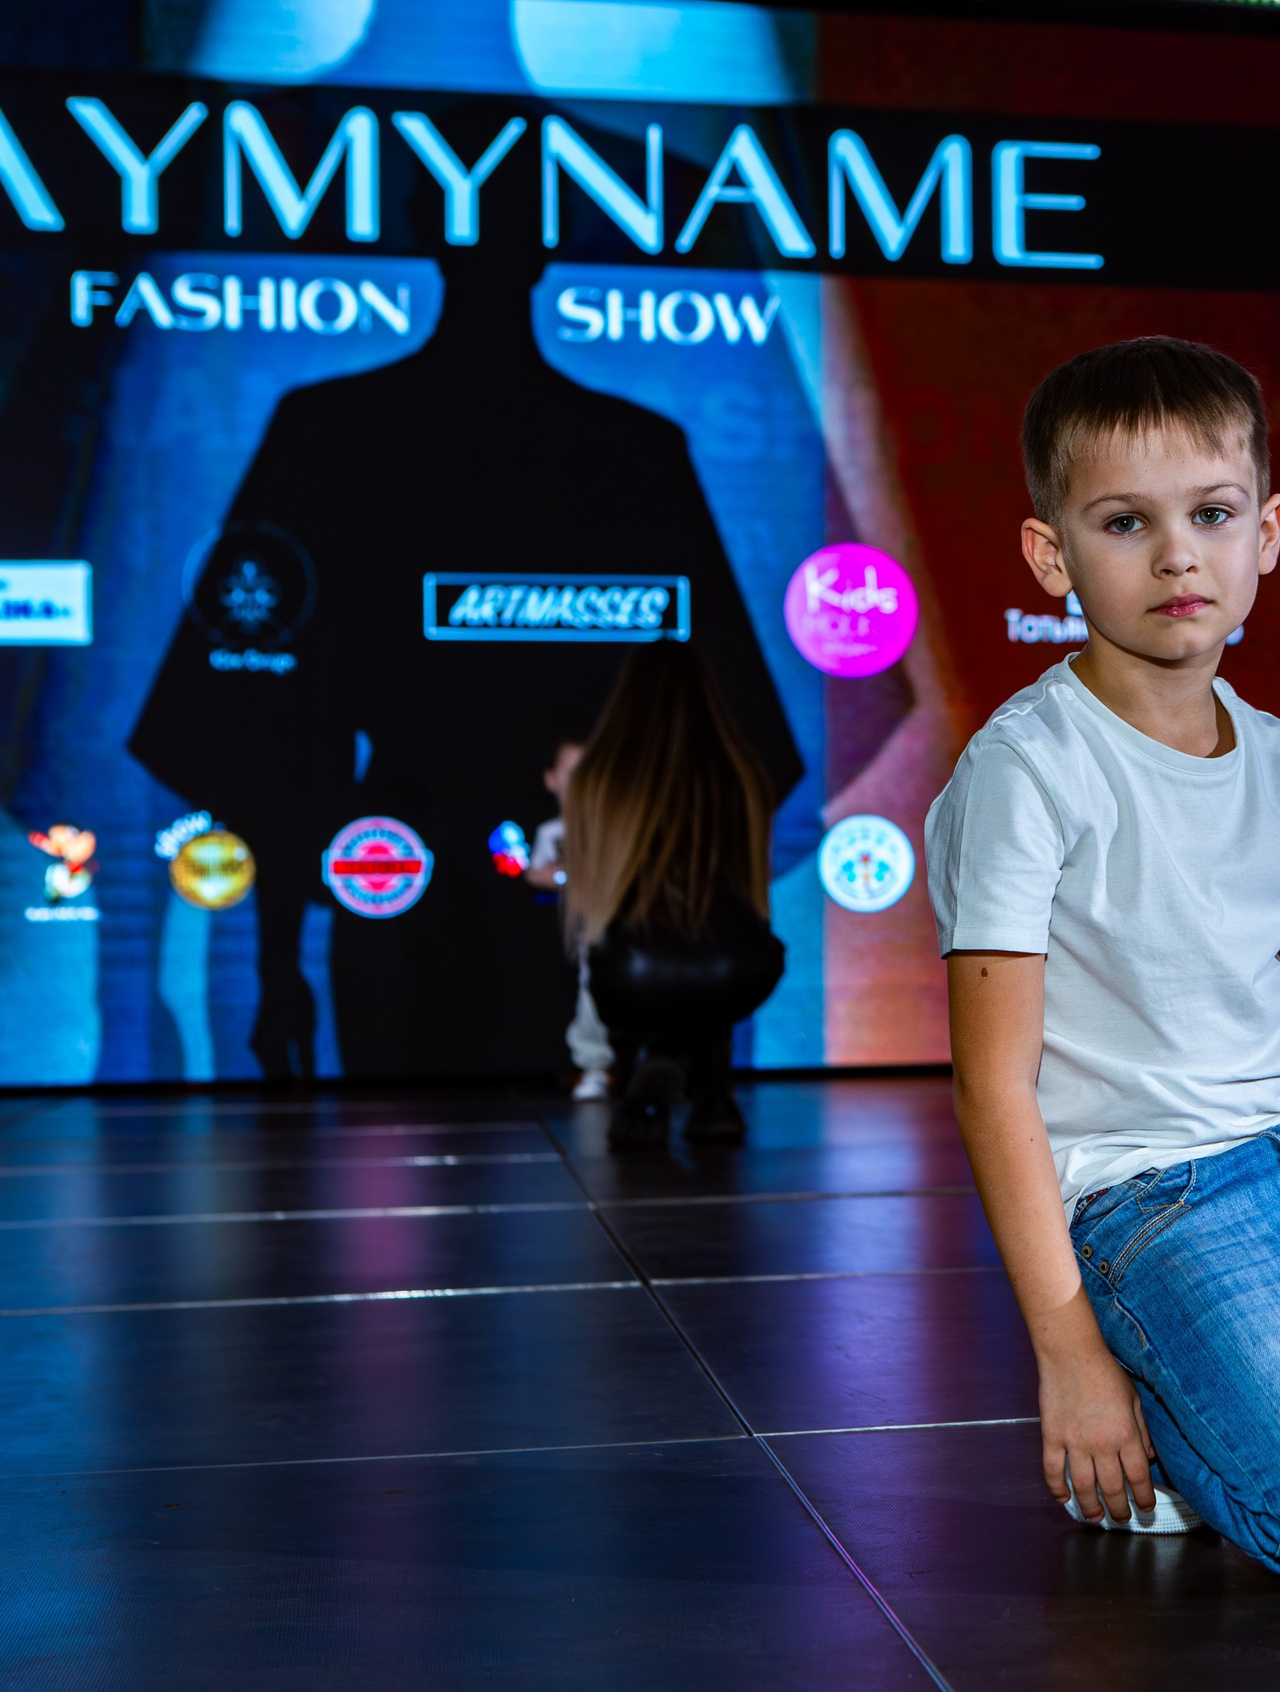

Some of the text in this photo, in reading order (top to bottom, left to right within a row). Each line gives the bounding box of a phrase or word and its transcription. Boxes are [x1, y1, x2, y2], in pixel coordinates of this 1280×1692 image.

[70, 270, 782, 346] FASHION SHOW
[449, 583, 670, 629] ARTMASSES
[804, 562, 899, 614] Kids
